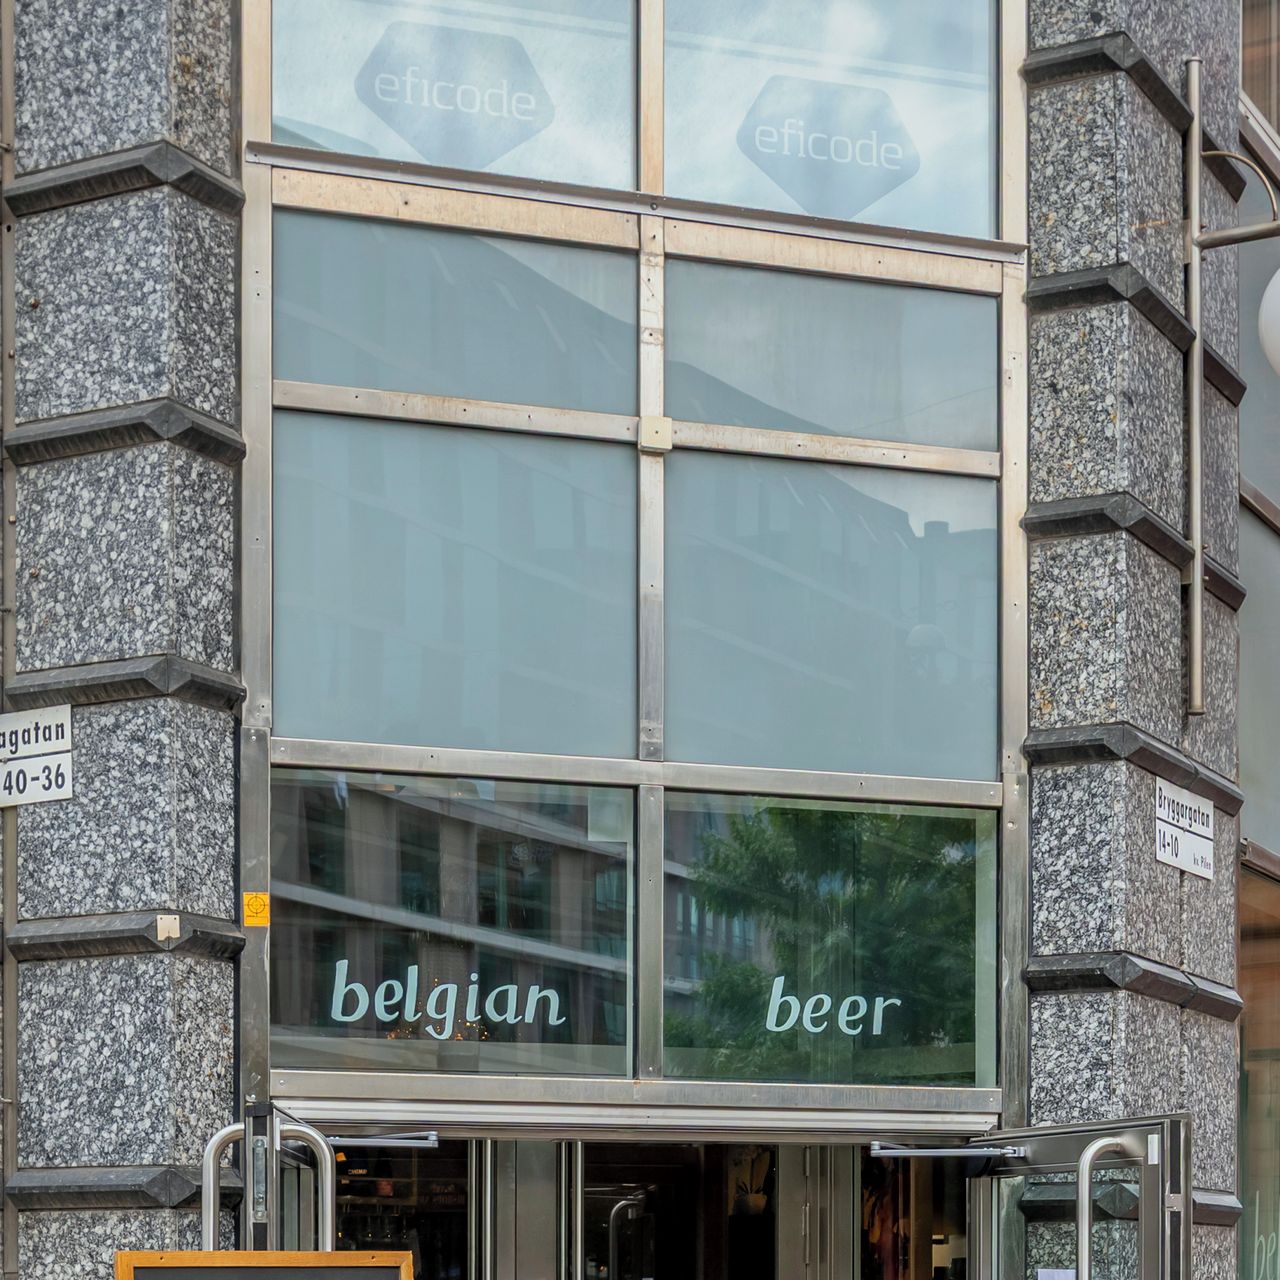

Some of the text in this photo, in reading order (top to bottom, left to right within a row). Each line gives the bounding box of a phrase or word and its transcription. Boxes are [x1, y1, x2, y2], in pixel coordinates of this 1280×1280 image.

[374, 66, 537, 121] eficode
[754, 117, 904, 170] eficode
[3, 763, 66, 796] 40-36
[1158, 785, 1210, 829] Bryggargatan
[1158, 828, 1179, 859] 14-10
[330, 959, 567, 1041] belgian
[765, 975, 902, 1036] beer
